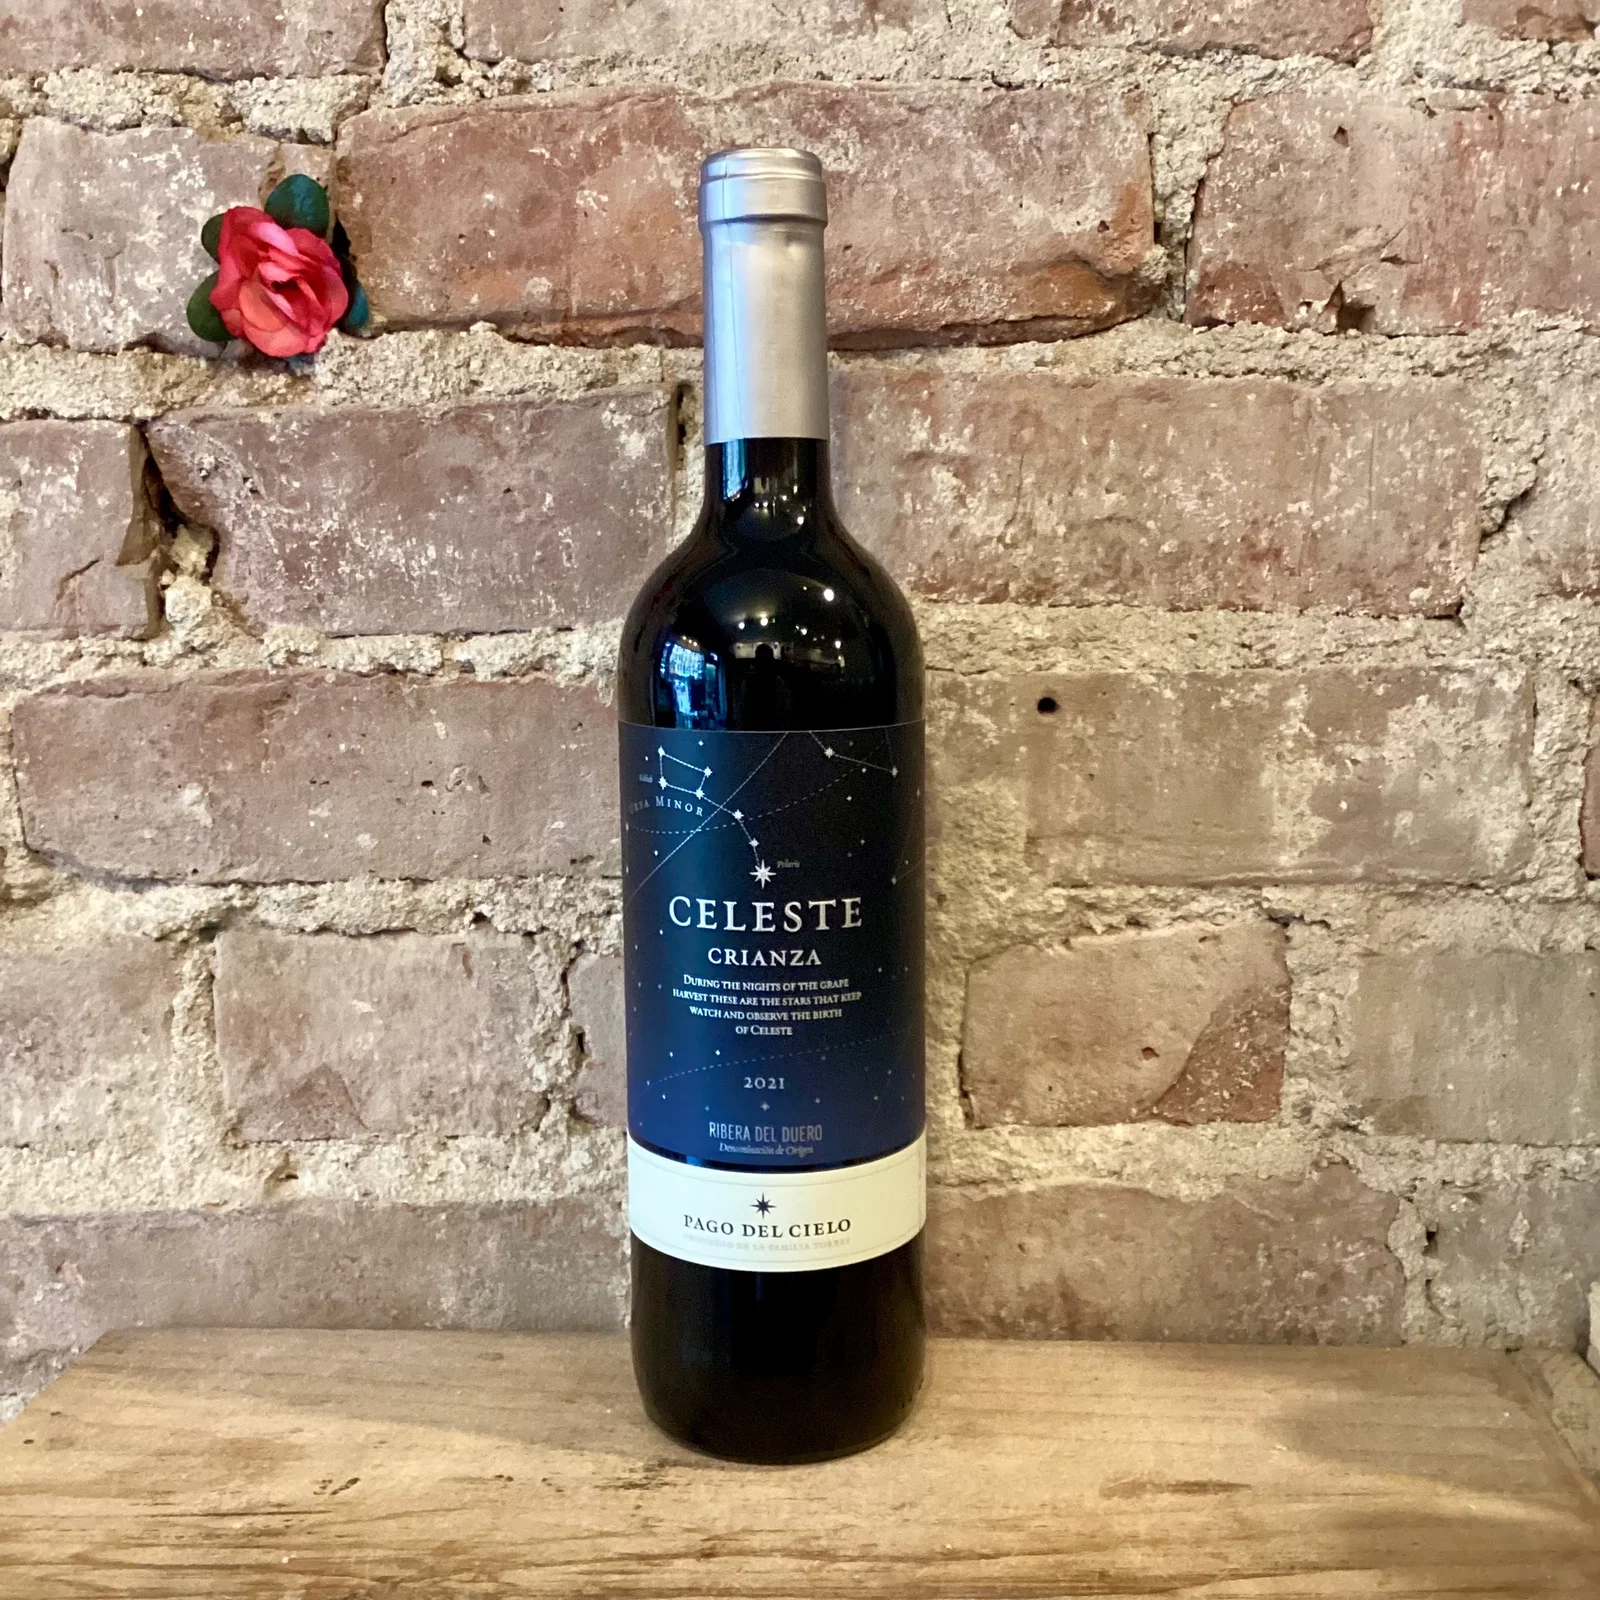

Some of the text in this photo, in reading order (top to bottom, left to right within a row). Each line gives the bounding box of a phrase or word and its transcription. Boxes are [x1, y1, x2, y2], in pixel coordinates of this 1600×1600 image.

[655, 796, 703, 816] MINOR
[668, 895, 862, 932] CELESTE
[707, 947, 822, 966] CRIANZA
[683, 974, 849, 991] DURING THE NIGHTS OF THE GRAPE
[672, 988, 862, 1006] HARVEST THESE ARE THE STARS THAT KEEP
[689, 1005, 843, 1021] WATCH AND OBSERVE THE BIRTH
[735, 1024, 793, 1036] OF CELESTE
[743, 1076, 785, 1090] 2021
[709, 1121, 823, 1143] RIBERA DEL DUERO
[684, 1214, 851, 1238] PAGO DEL CIELO
